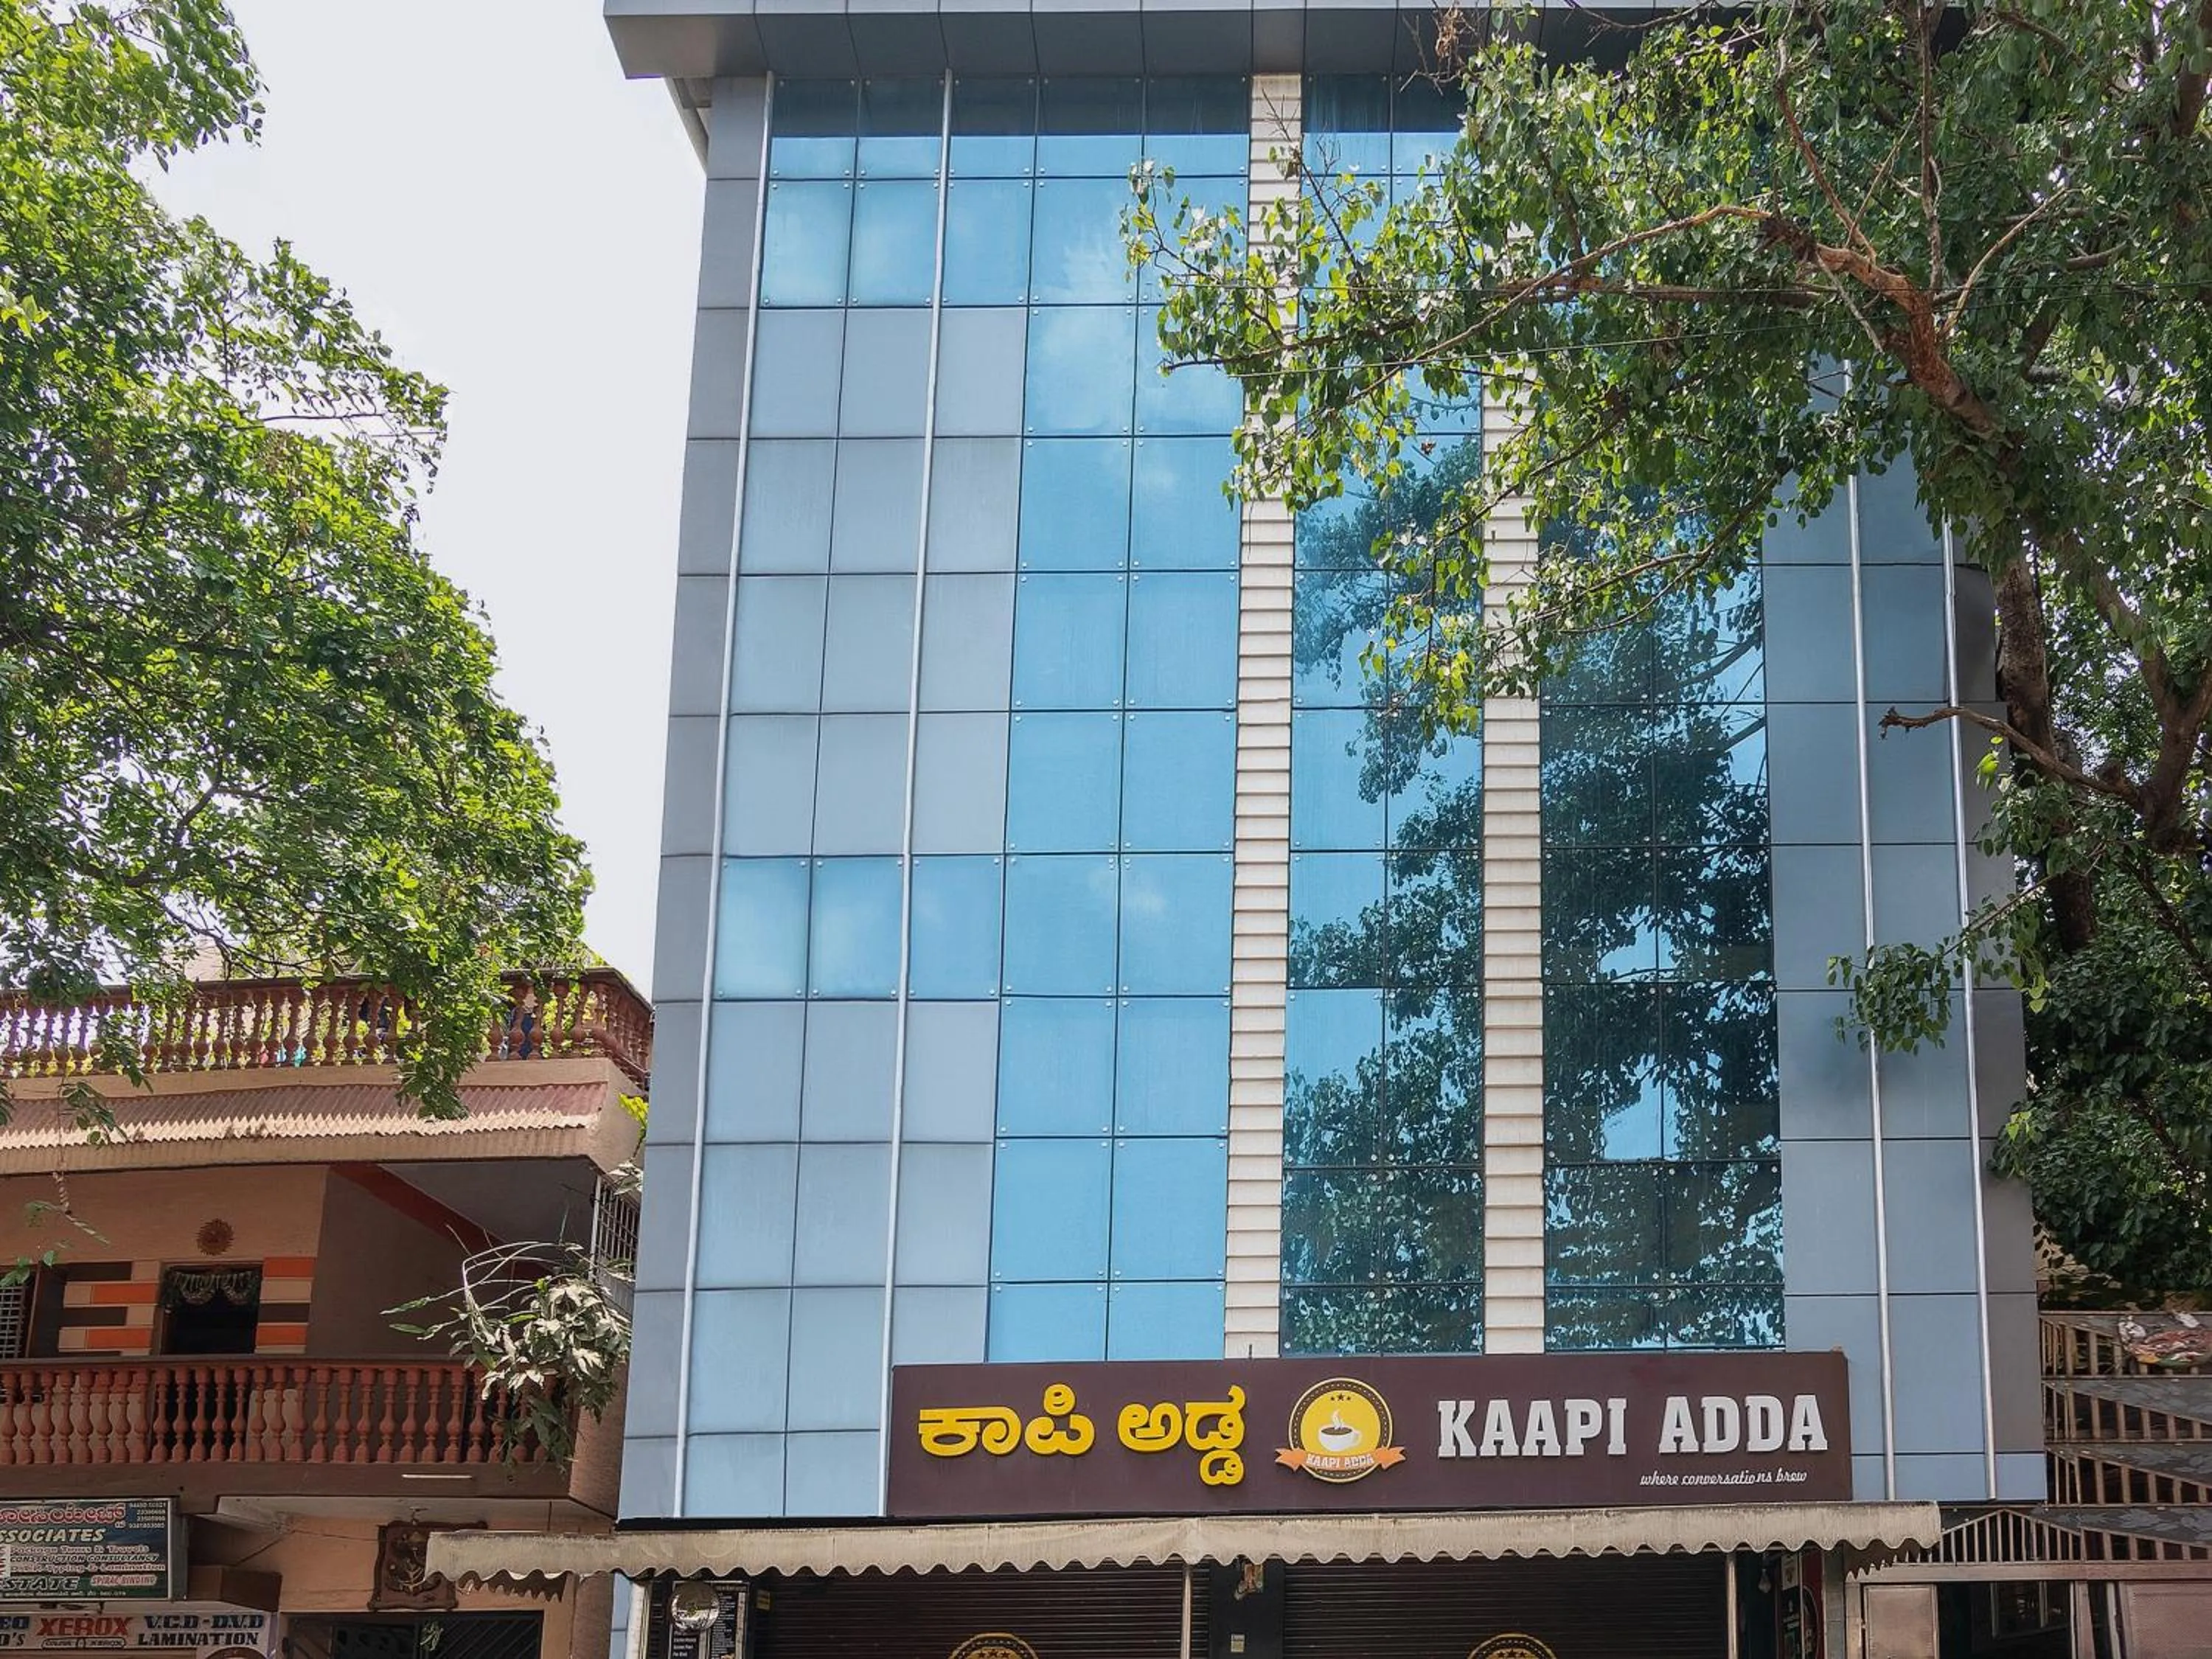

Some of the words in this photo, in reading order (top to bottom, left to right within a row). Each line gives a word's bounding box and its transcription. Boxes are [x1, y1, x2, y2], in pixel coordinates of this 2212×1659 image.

[918, 1383, 1096, 1457] ಕಾಪಿ
[1437, 1397, 1628, 1458] KAAPI
[1658, 1394, 1829, 1455] ADDA
[1306, 1453, 1341, 1468] KAAPI
[1344, 1453, 1375, 1467] ADDA
[1640, 1470, 1679, 1486] where
[1681, 1469, 1773, 1486] conversations
[1775, 1467, 1807, 1483] brew
[37, 1617, 133, 1636] XEROX
[138, 1632, 260, 1646] LAMINATION
